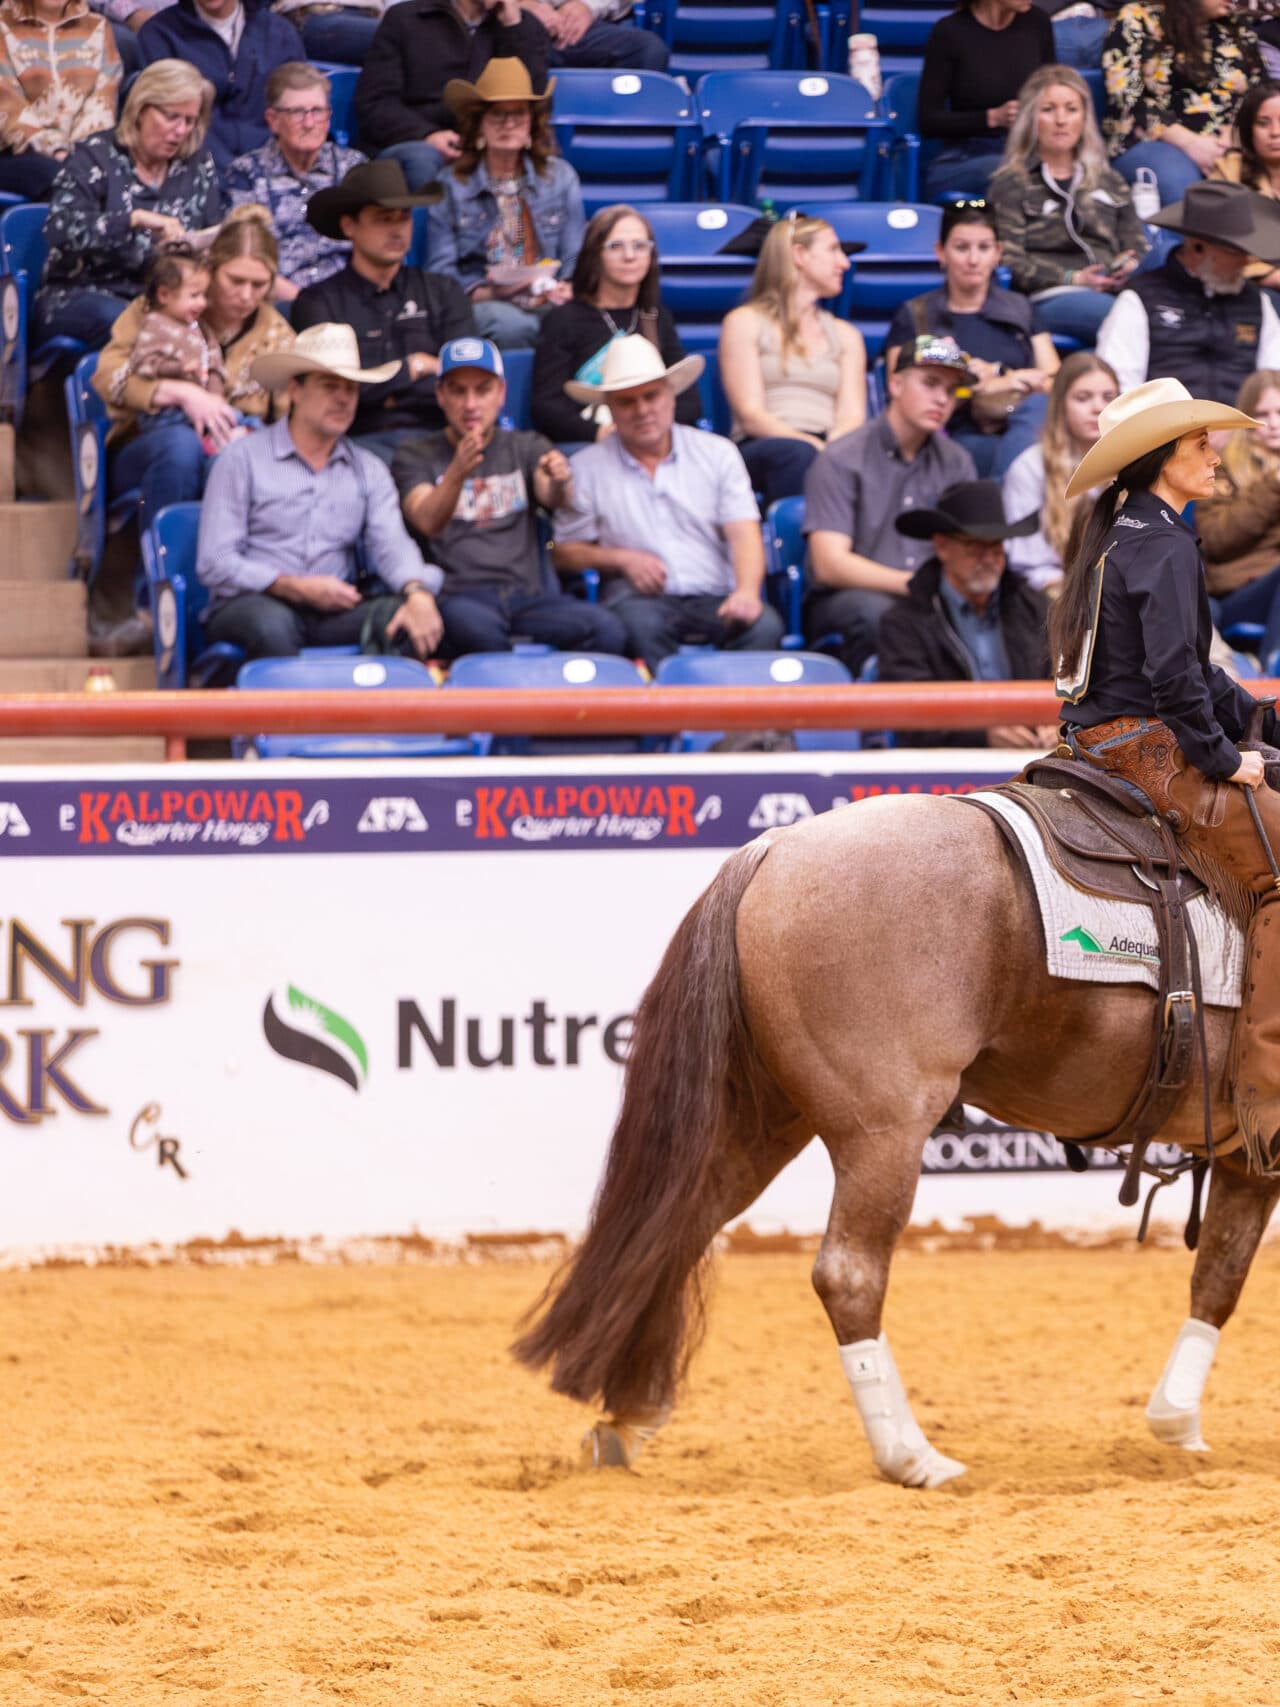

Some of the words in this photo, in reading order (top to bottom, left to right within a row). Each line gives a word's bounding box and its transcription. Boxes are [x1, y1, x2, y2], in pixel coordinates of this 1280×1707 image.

[79, 790, 305, 843] KALPOWAR
[116, 820, 202, 846] Quarter
[475, 785, 698, 838] KALPOWAR
[511, 815, 594, 841] Quarter
[0, 917, 180, 1007] NG
[922, 1131, 1070, 1171] OCKIN
